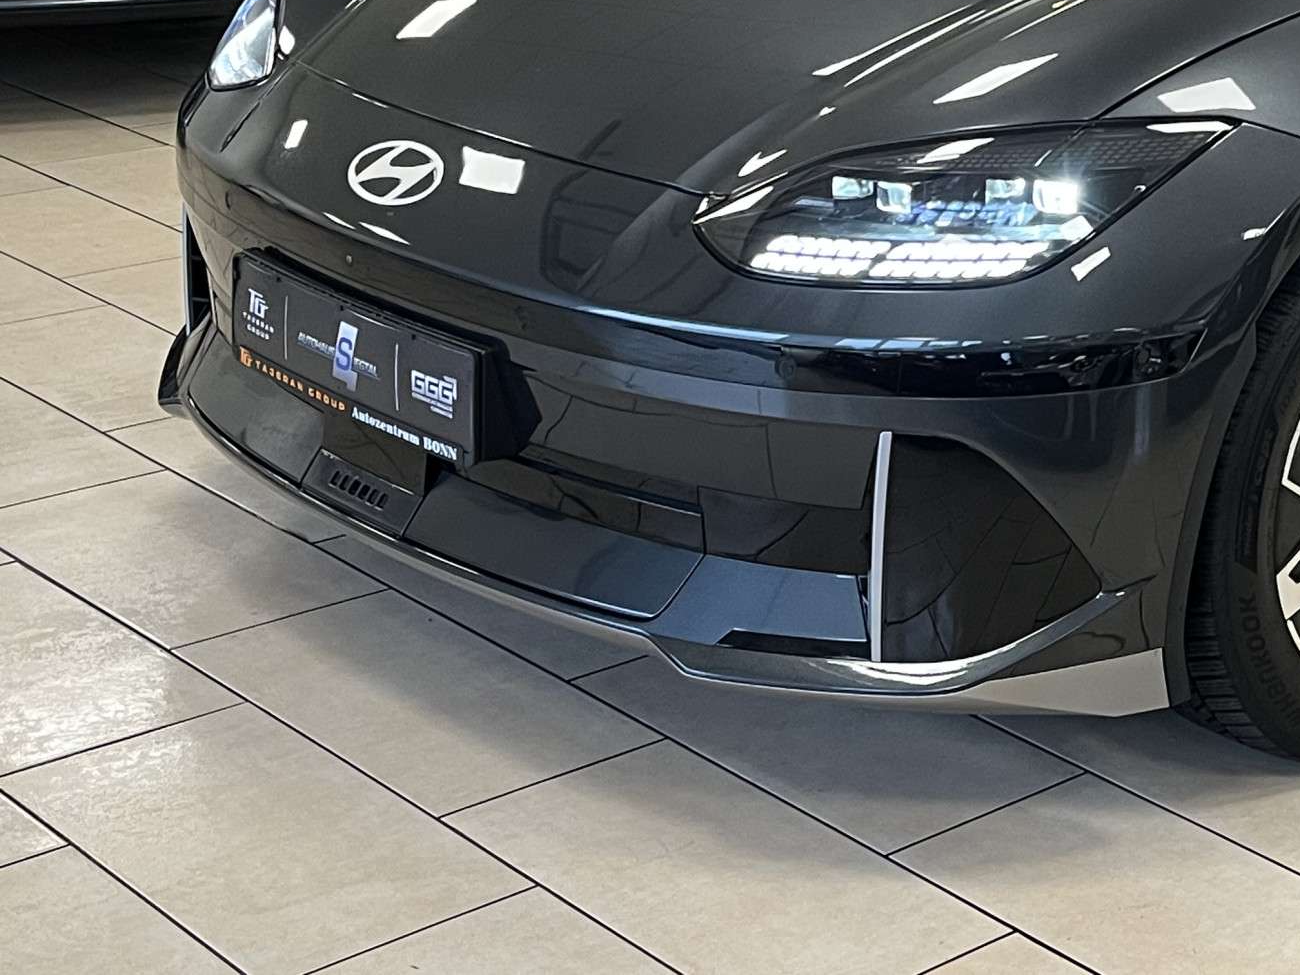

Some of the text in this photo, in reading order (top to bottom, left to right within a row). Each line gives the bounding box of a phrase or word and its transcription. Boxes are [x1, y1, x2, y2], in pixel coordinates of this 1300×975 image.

[411, 370, 454, 405] GGG
[351, 406, 420, 446] Autozentrum
[422, 436, 458, 461] BONN
